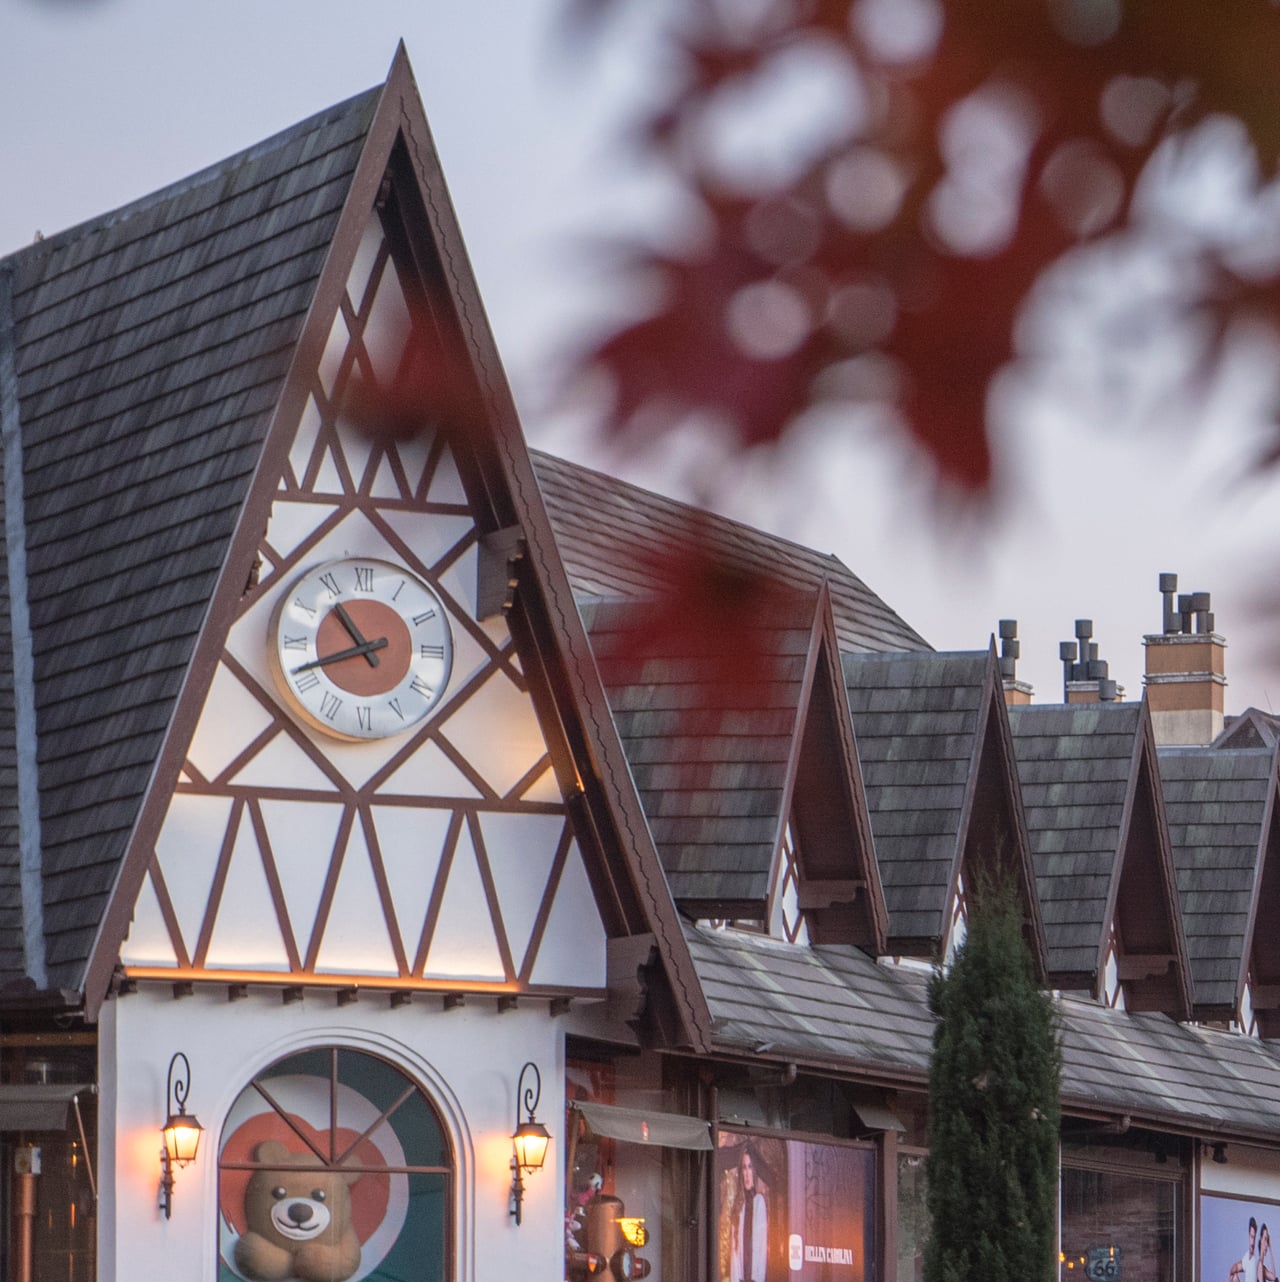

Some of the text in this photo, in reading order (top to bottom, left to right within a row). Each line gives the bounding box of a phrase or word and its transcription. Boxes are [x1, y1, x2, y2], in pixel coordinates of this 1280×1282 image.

[319, 572, 343, 598] XI
[354, 567, 374, 592] XII
[294, 598, 317, 618] X
[412, 609, 436, 627] II
[284, 635, 307, 651] IX
[421, 644, 444, 660] III
[409, 675, 434, 700] IV
[319, 691, 344, 721] VII
[388, 698, 406, 721] V
[356, 706, 373, 731] VI
